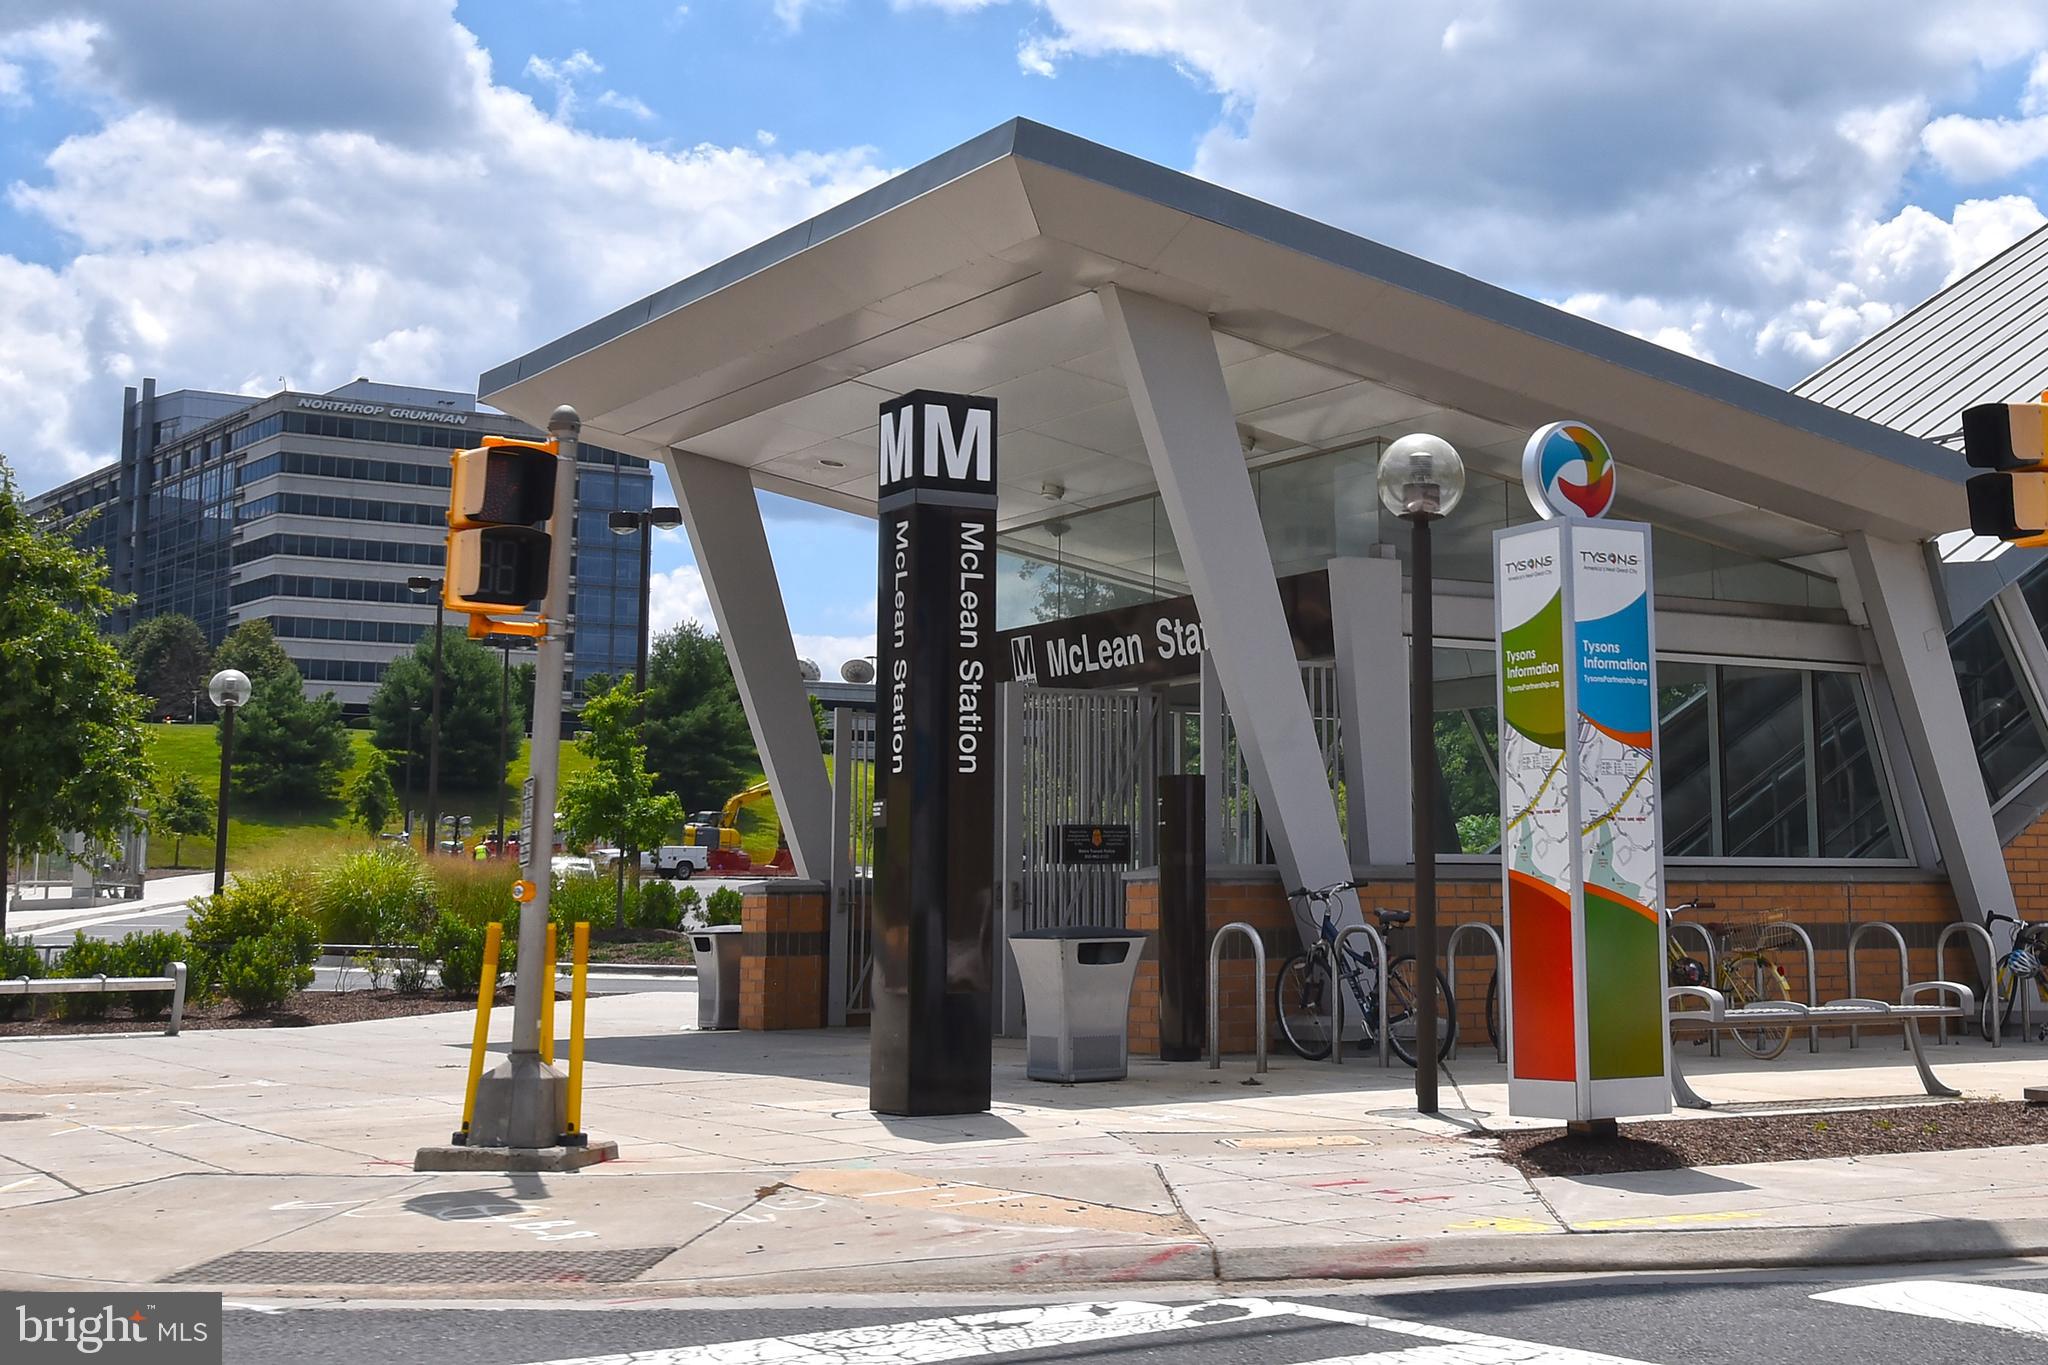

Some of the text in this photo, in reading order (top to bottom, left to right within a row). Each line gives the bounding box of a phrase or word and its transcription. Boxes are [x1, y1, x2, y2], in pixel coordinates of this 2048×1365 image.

[298, 398, 468, 425] NORTHROP GRUMMAN
[880, 404, 913, 486] M
[924, 404, 991, 481] M
[1580, 551, 1638, 566] TYSONS
[892, 520, 909, 773] McLean Station
[958, 522, 985, 773] McLean Station
[1046, 633, 1145, 678] McLean
[1506, 649, 1536, 665] Tysons
[1582, 640, 1620, 654] Tysons
[1507, 662, 1560, 679] Information
[1583, 657, 1647, 672] Information
